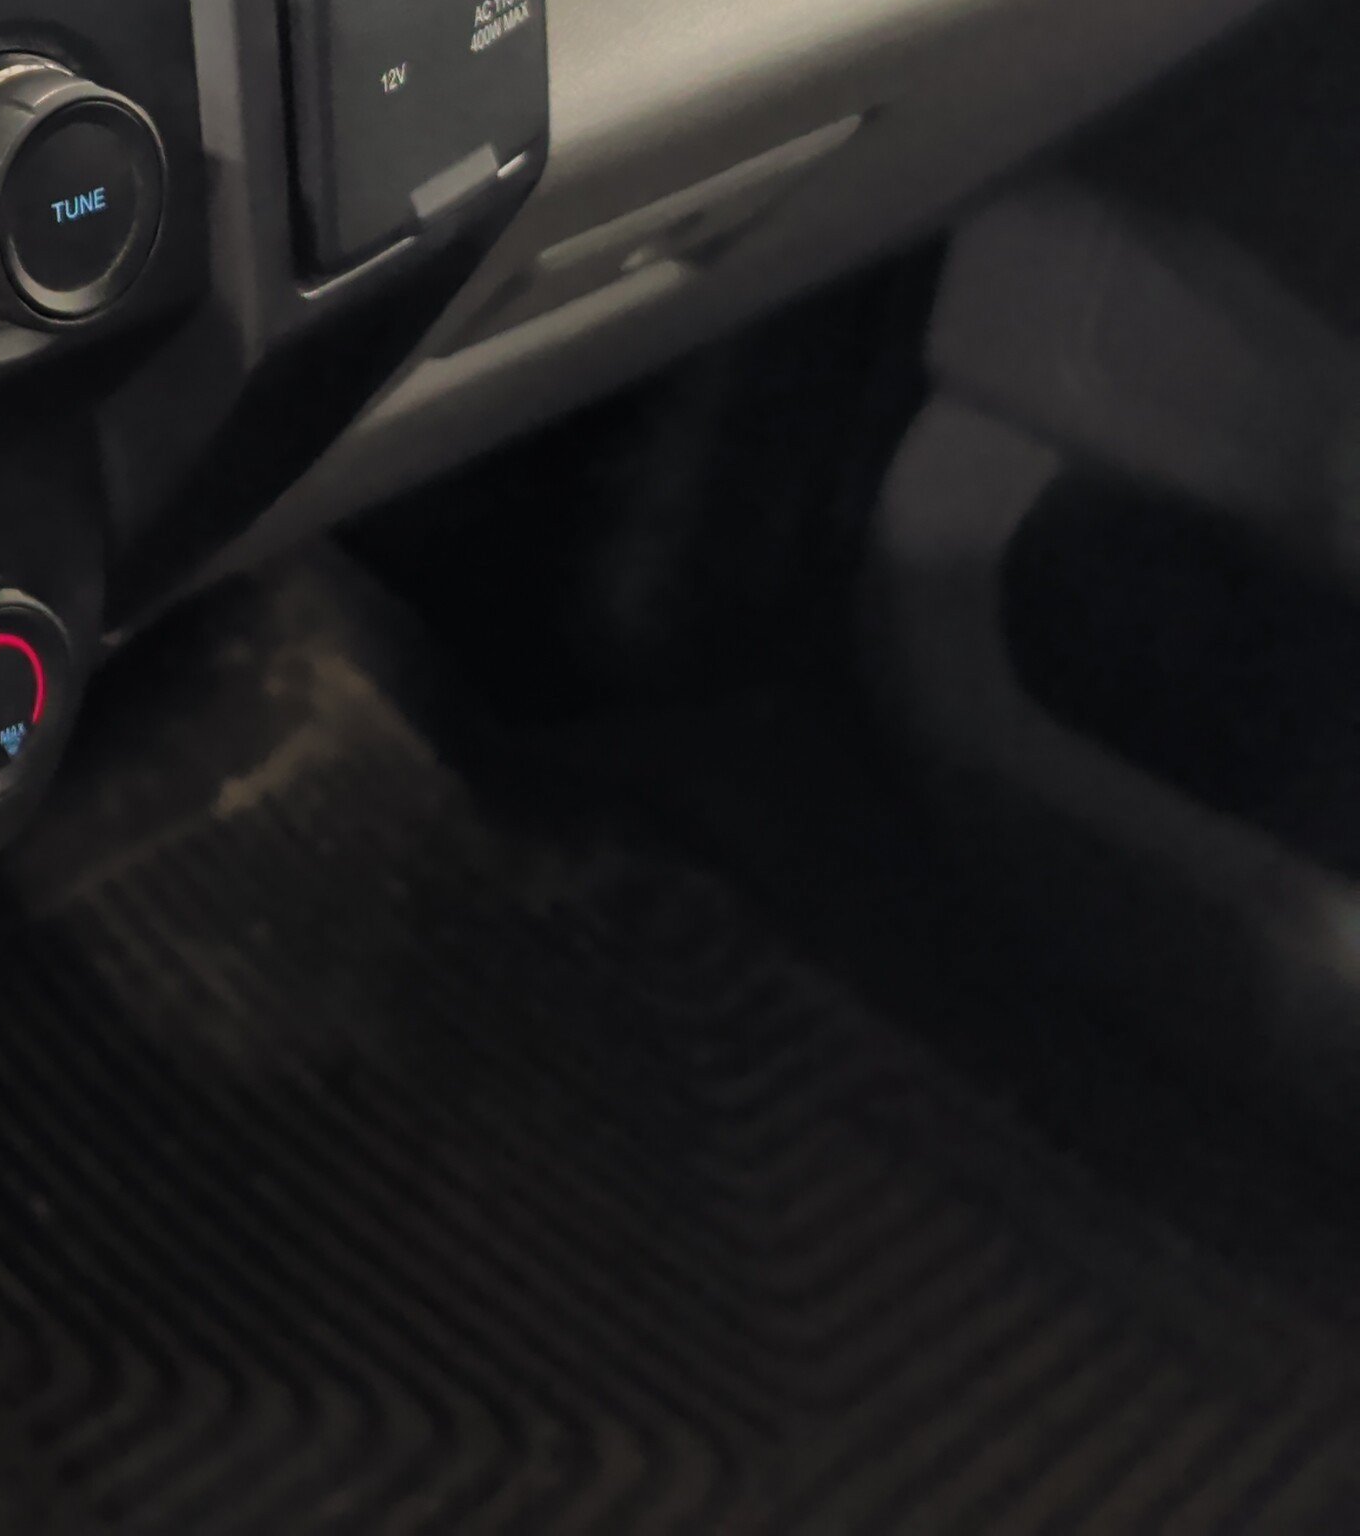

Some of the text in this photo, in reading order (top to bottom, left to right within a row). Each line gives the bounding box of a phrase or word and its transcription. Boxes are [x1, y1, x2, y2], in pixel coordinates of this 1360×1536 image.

[474, 0, 493, 27] AC
[502, 0, 529, 31] MAX
[381, 62, 407, 93] 12V
[50, 186, 106, 224] TUNE
